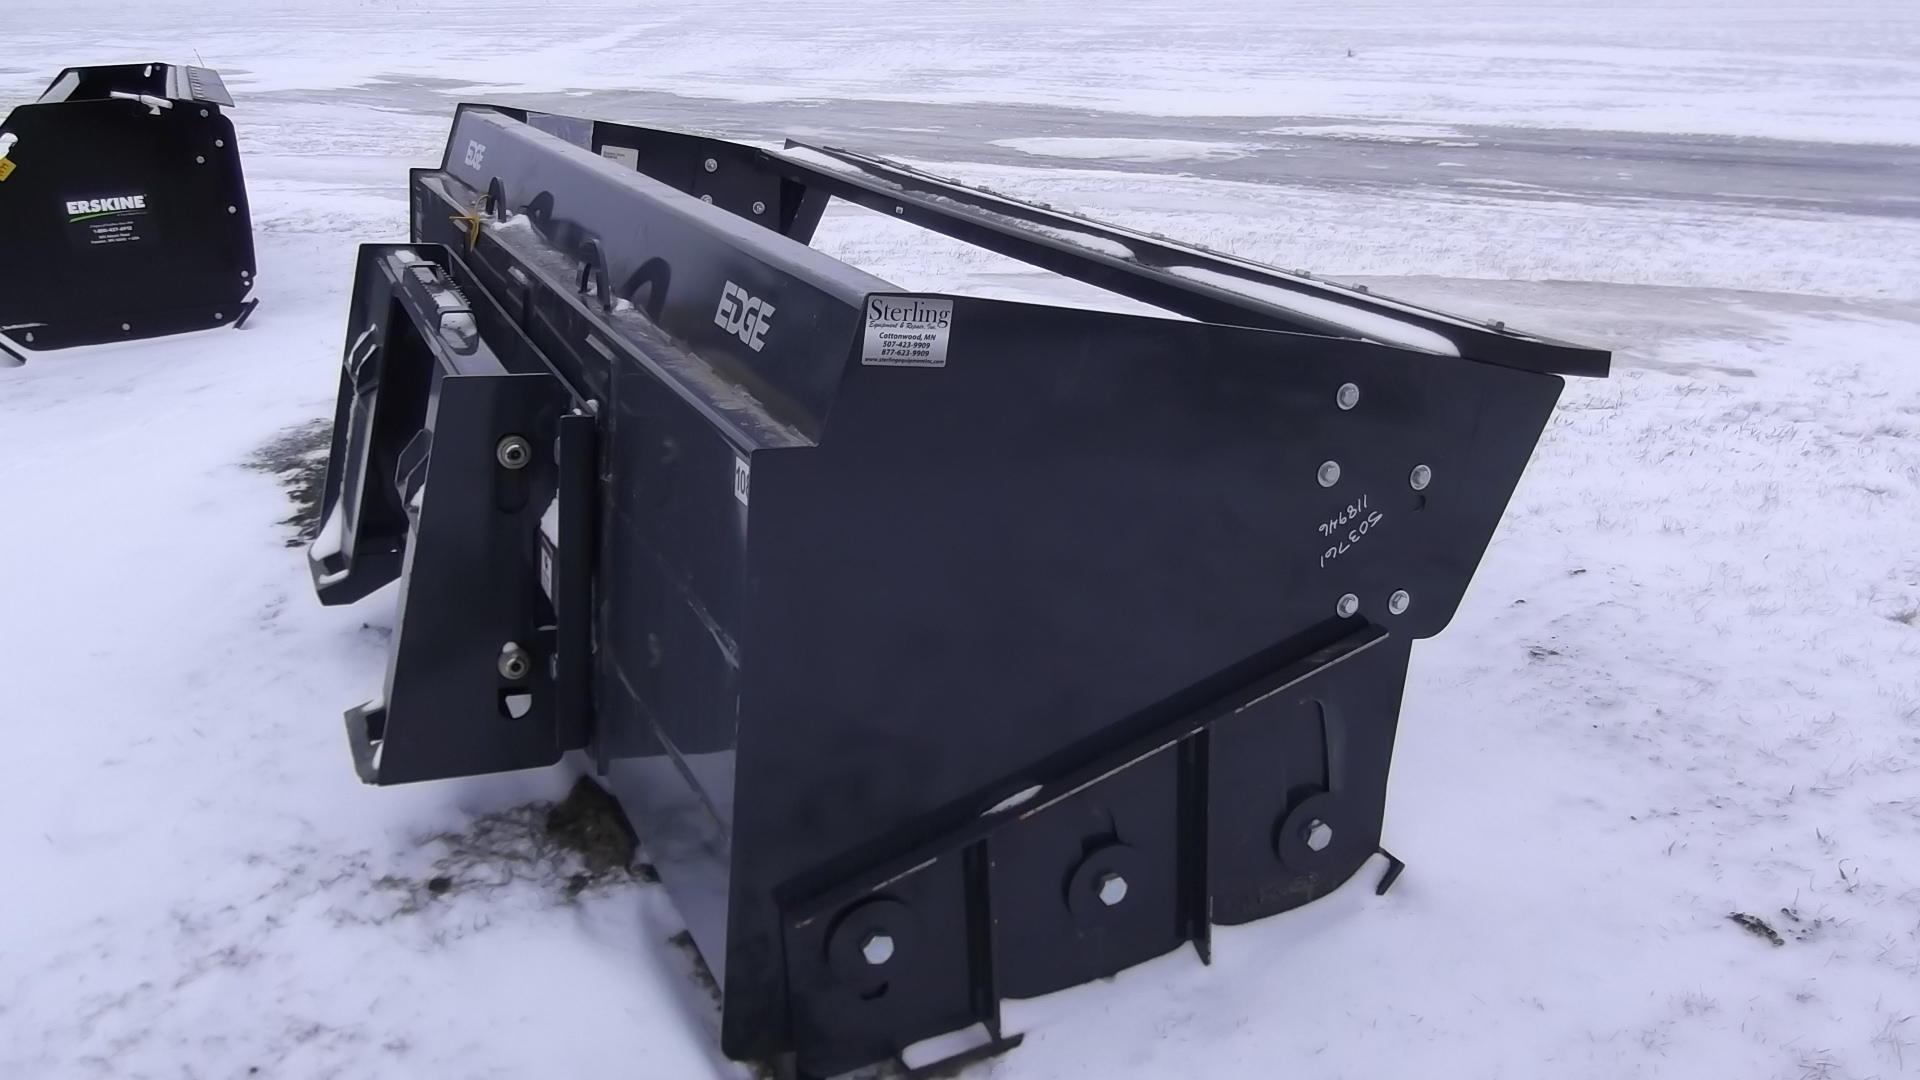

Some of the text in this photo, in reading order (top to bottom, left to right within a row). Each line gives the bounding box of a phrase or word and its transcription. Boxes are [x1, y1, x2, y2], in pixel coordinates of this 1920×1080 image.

[464, 139, 486, 171] EDGE
[66, 195, 145, 215] ERSKINE
[714, 280, 776, 352] EDGE
[869, 299, 951, 328] Sterling
[869, 320, 898, 329] Equipment
[879, 332, 922, 341] Cottonwood,
[882, 341, 931, 349] 507-423-9909
[881, 349, 930, 357] 877-623-9909
[1318, 494, 1367, 536] 118946
[1320, 511, 1383, 568] 503761
